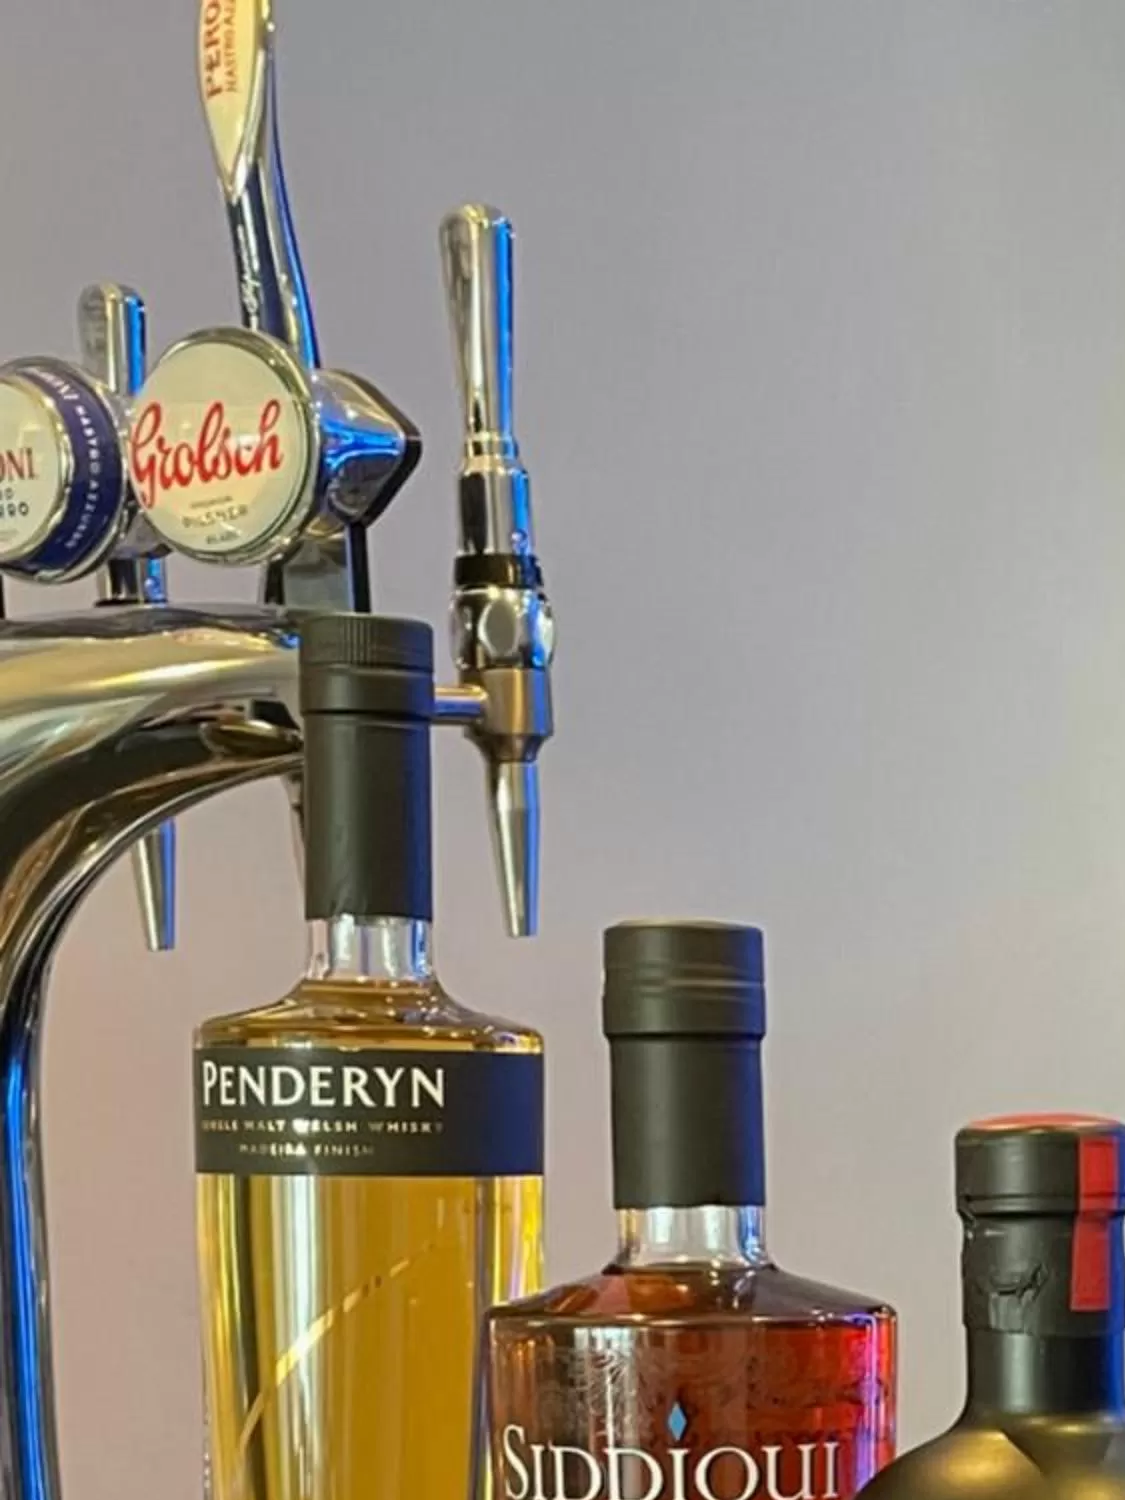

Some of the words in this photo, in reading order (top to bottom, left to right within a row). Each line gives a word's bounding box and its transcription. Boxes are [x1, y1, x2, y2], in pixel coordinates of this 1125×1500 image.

[131, 400, 284, 510] Grolsch
[202, 1060, 445, 1108] PENDERYN
[243, 1119, 286, 1133] MALT
[291, 1117, 359, 1135] WELSH
